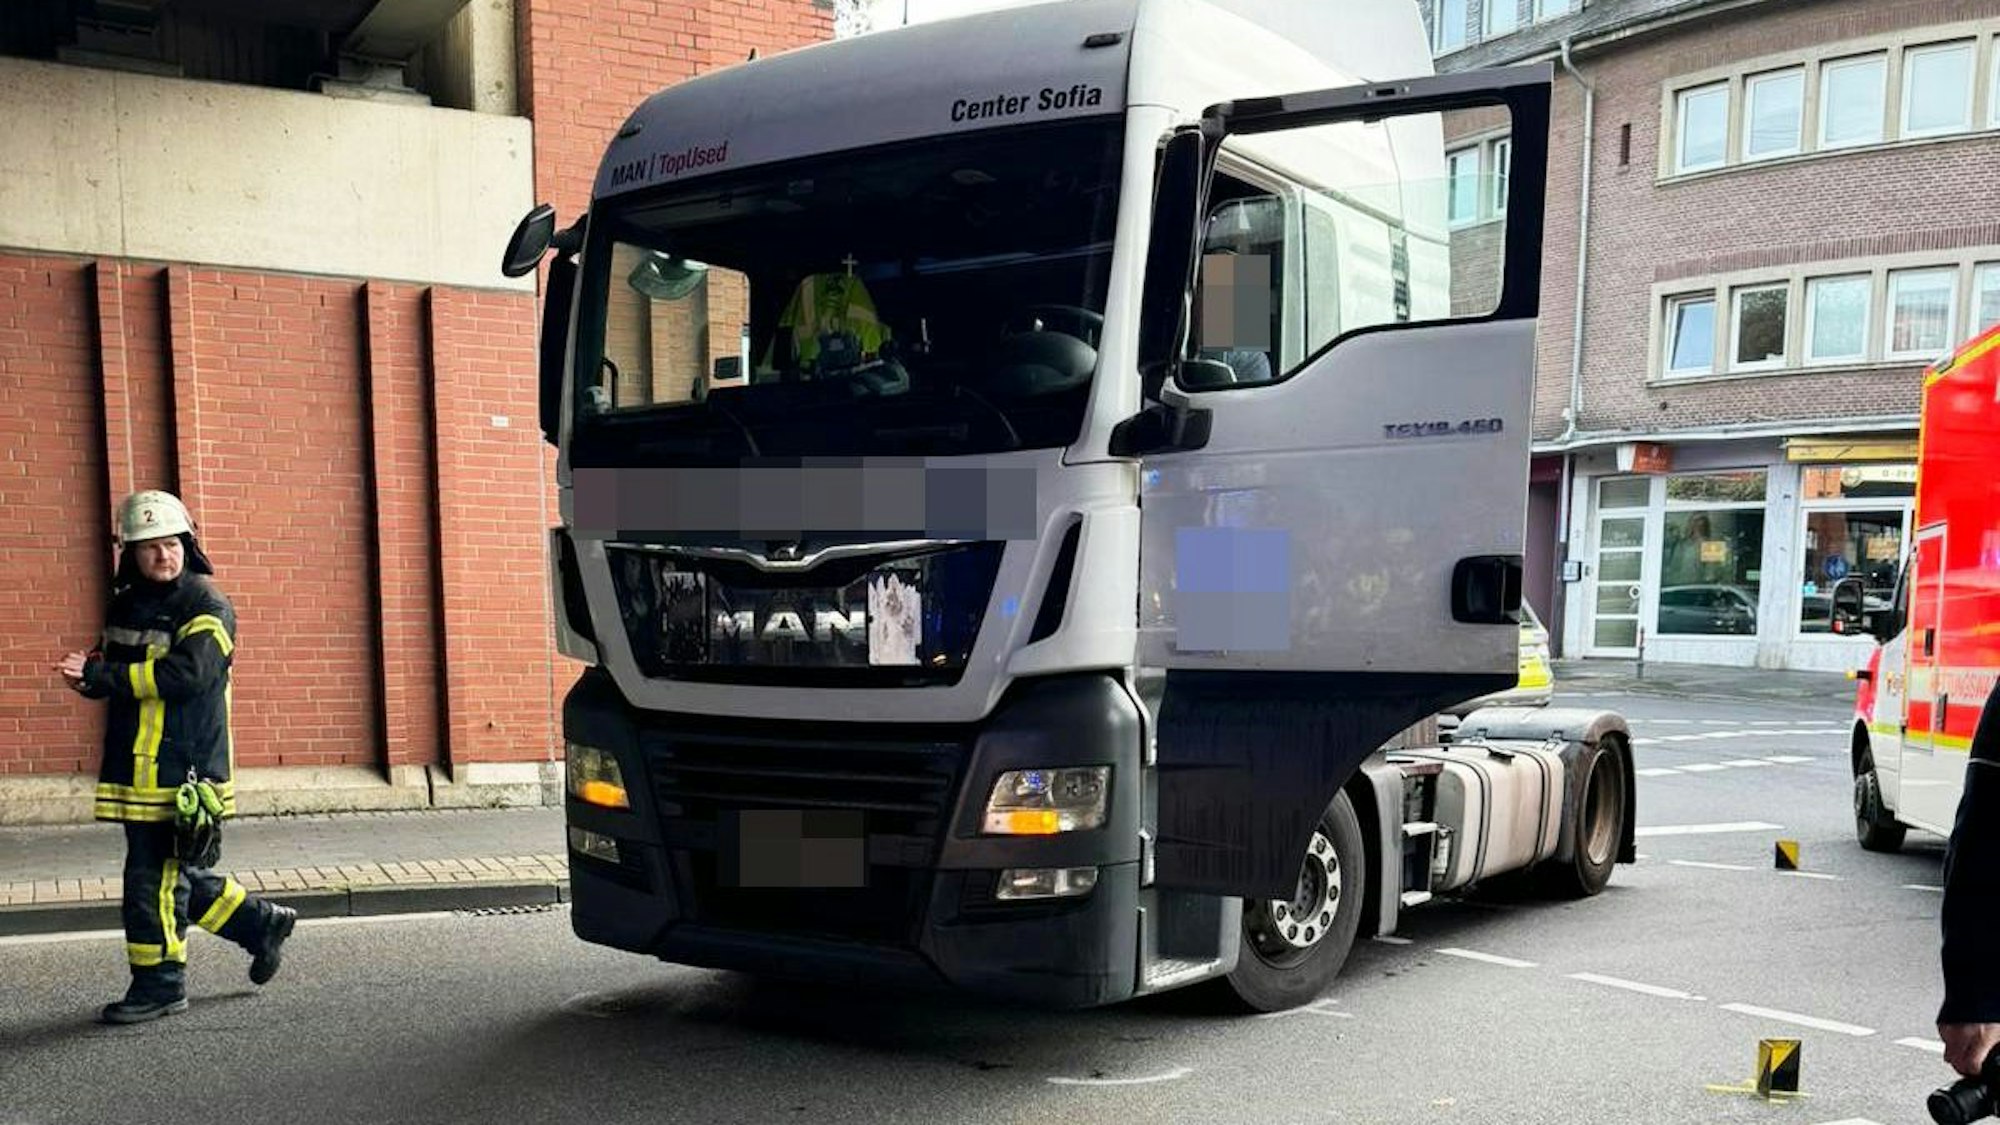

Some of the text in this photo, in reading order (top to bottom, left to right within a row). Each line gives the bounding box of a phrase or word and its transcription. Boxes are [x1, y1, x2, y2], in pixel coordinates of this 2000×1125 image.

[951, 84, 1102, 122] Center Sofia
[611, 140, 728, 188] MAN TopUsed
[144, 509, 155, 522] 2
[711, 610, 867, 642] MAN
